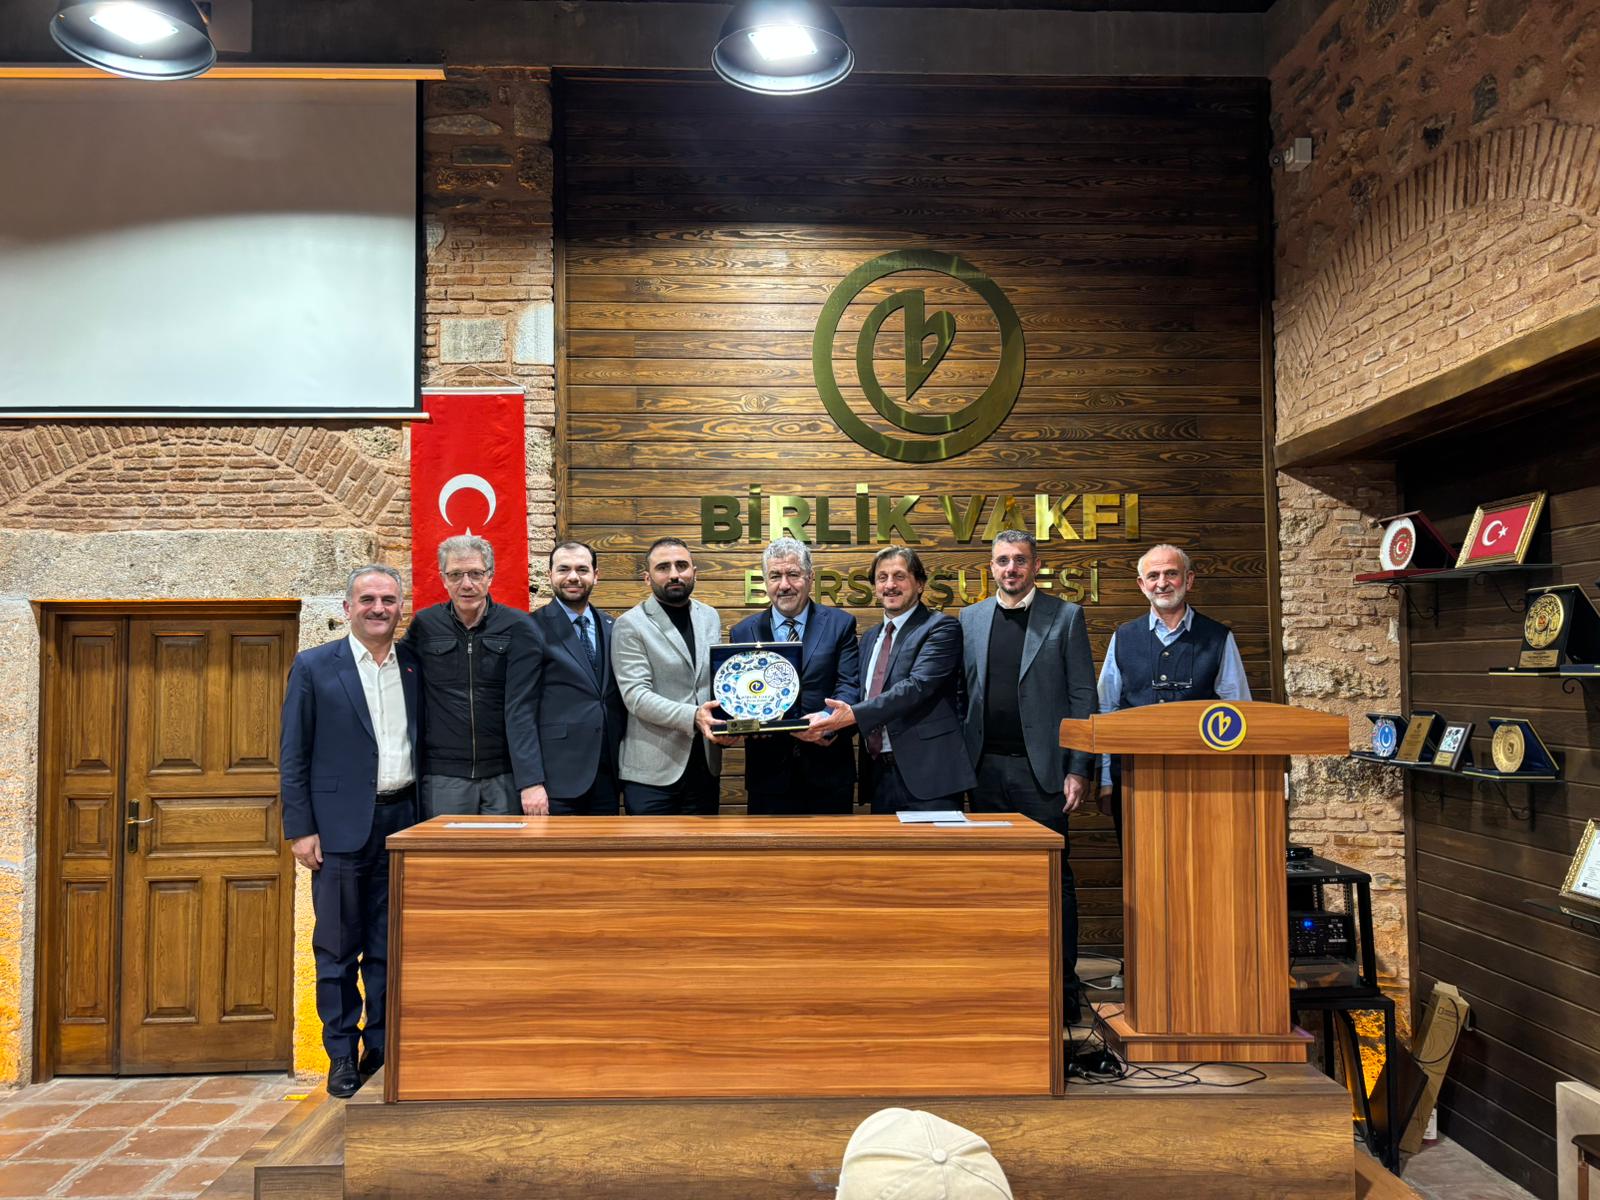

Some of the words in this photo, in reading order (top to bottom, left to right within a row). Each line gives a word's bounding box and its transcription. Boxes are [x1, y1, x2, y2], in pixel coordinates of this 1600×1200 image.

[701, 483, 921, 544] BİRLİK
[938, 494, 1139, 543] VAKFI
[744, 568, 885, 607] BRS
[927, 560, 1099, 611] ŞUSİ
